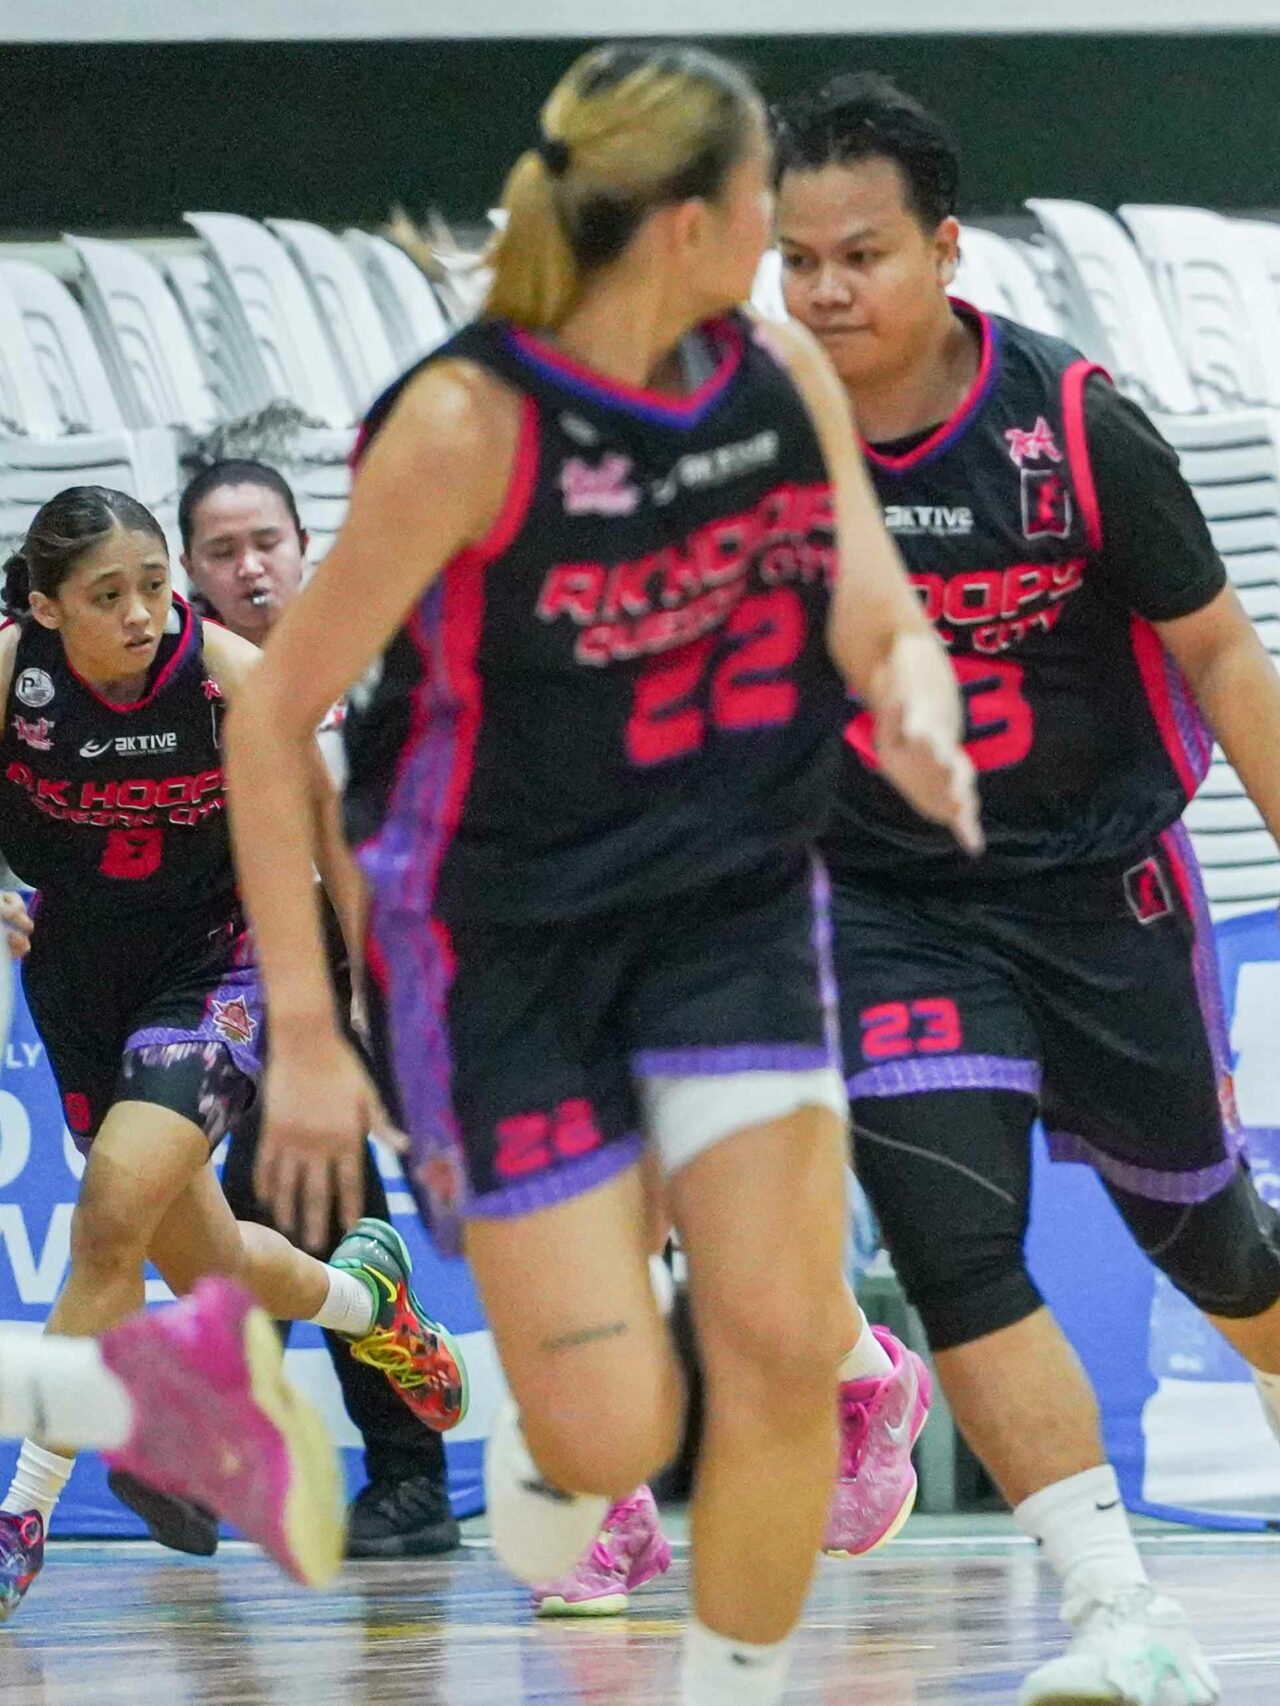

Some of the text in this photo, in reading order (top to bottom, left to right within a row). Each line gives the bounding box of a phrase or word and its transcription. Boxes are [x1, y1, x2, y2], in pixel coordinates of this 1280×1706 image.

[624, 587, 804, 767] 22
[844, 655, 1034, 772] 3
[80, 767, 229, 811] HOOP
[99, 828, 164, 879] 8
[859, 997, 963, 1058] 23
